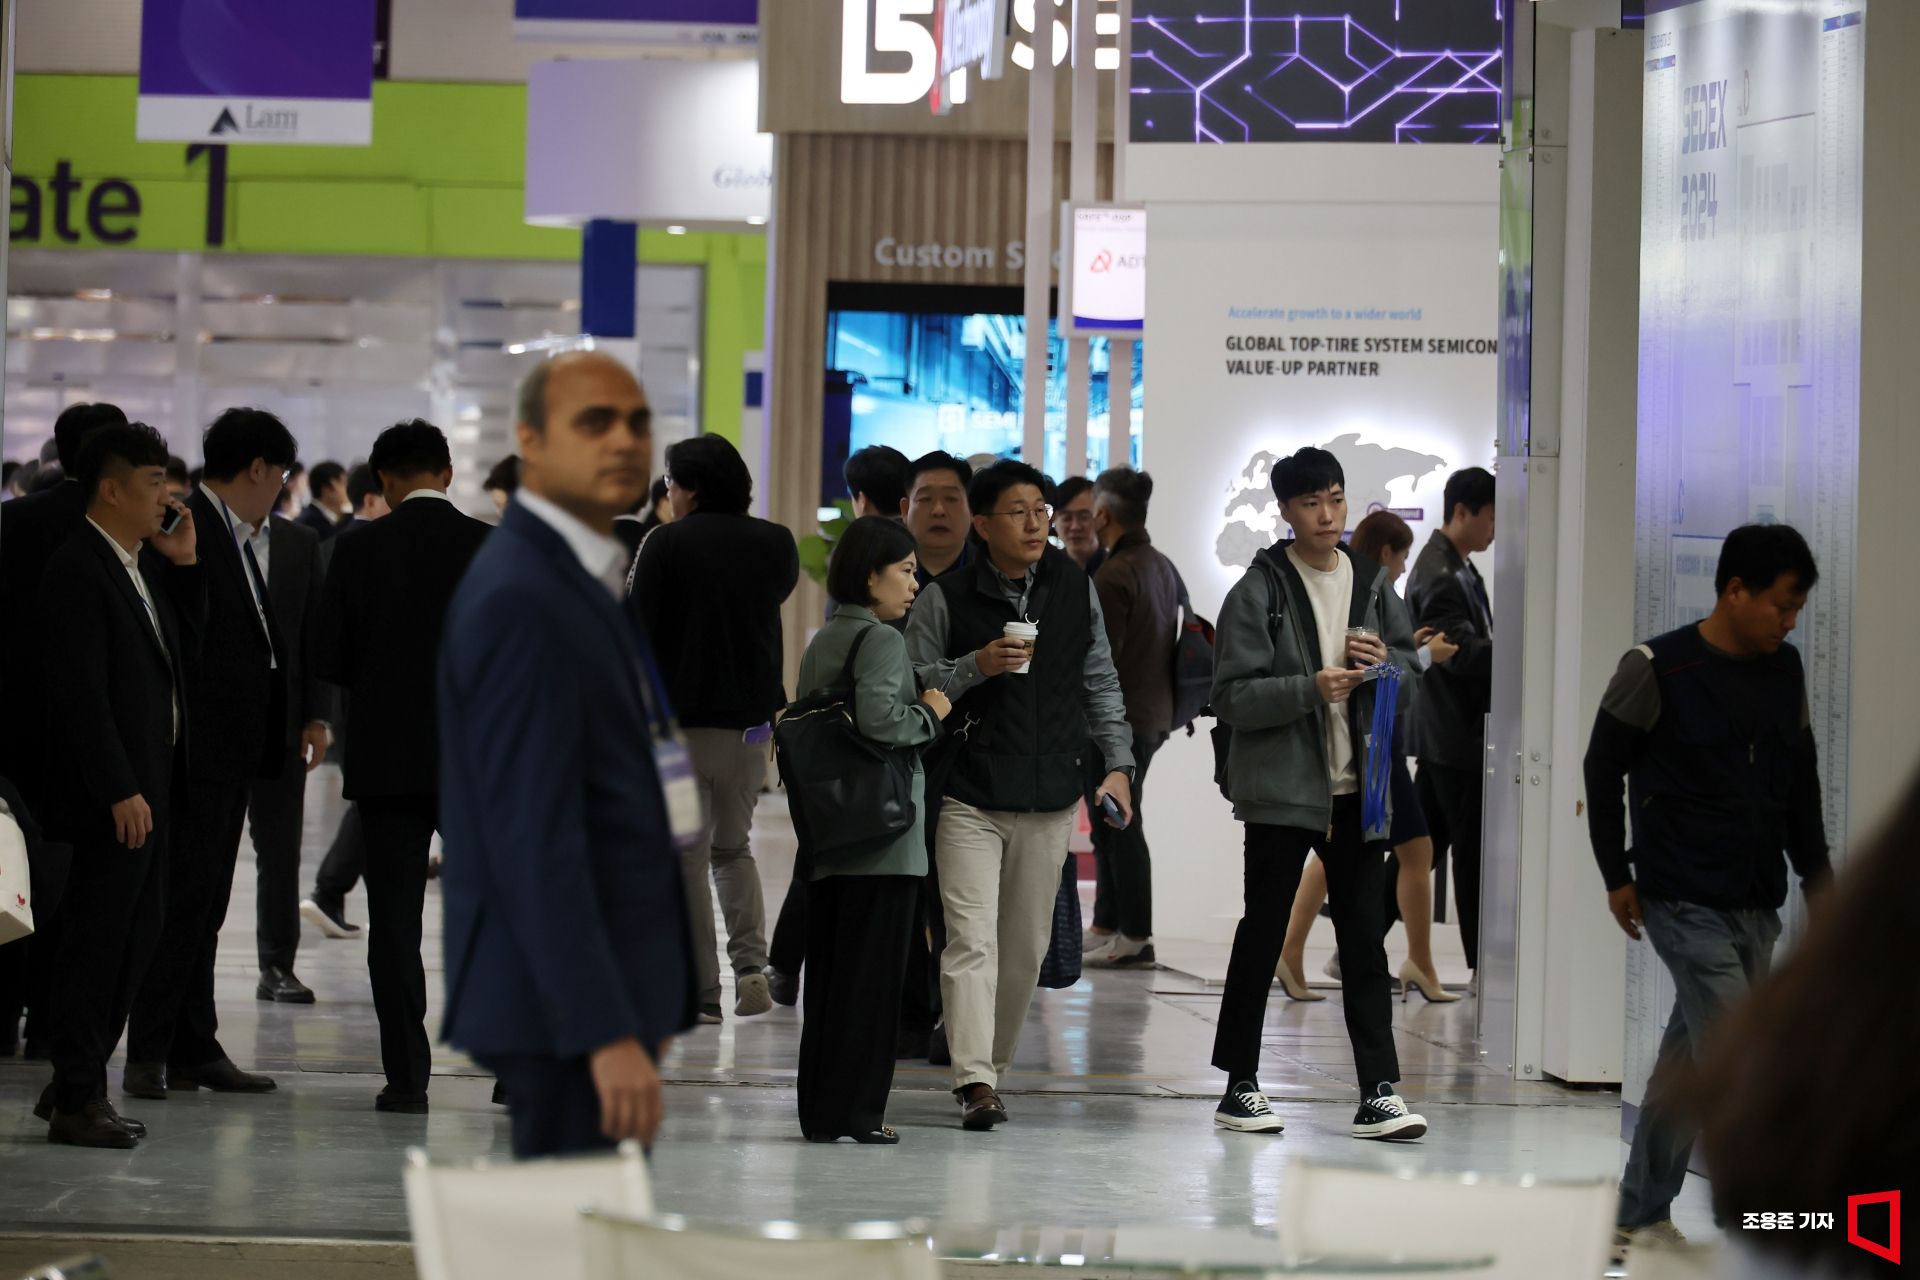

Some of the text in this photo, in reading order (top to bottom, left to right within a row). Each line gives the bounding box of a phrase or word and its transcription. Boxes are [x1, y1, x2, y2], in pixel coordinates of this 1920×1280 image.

[1681, 79, 1727, 155] SEDEX
[184, 142, 229, 246] 1
[1681, 171, 1718, 242] 2024
[874, 237, 994, 268] Custom
[1228, 307, 1422, 322] Accelerate growth to a wider world
[1226, 336, 1498, 354] GLOBAL TOP-TIRE SYSTEM SEMICON
[1226, 360, 1379, 376] VALUE-UP PARTNER
